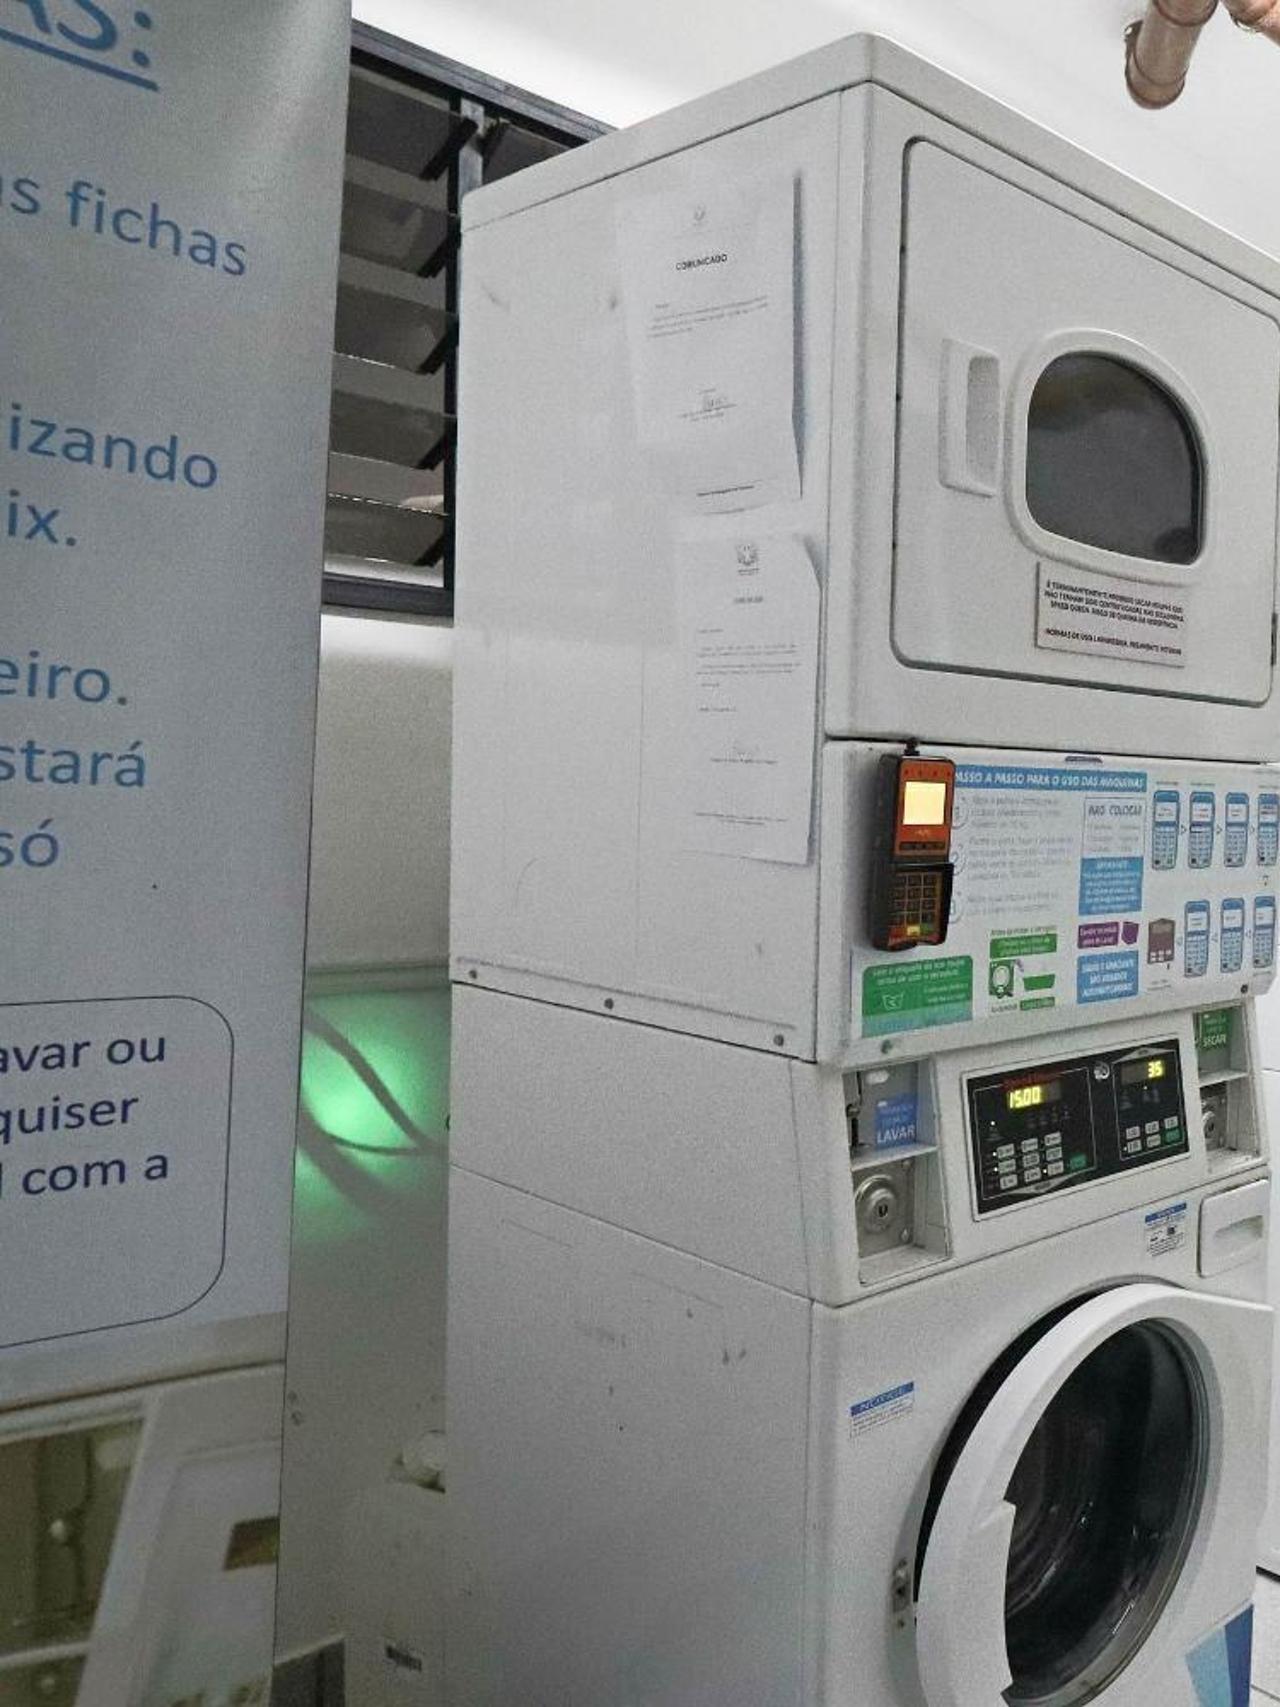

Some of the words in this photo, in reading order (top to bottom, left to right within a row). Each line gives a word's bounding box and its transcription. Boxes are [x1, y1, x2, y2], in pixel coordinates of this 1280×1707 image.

[65, 181, 246, 276] fichas
[0, 651, 128, 706] eiro.
[0, 740, 146, 788] stará
[0, 818, 60, 868] só
[107, 1037, 166, 1065] ou
[1148, 1060, 1163, 1079] 35
[876, 1124, 916, 1144] LAVAR
[22, 1159, 126, 1195] com
[144, 1154, 168, 1181] a
